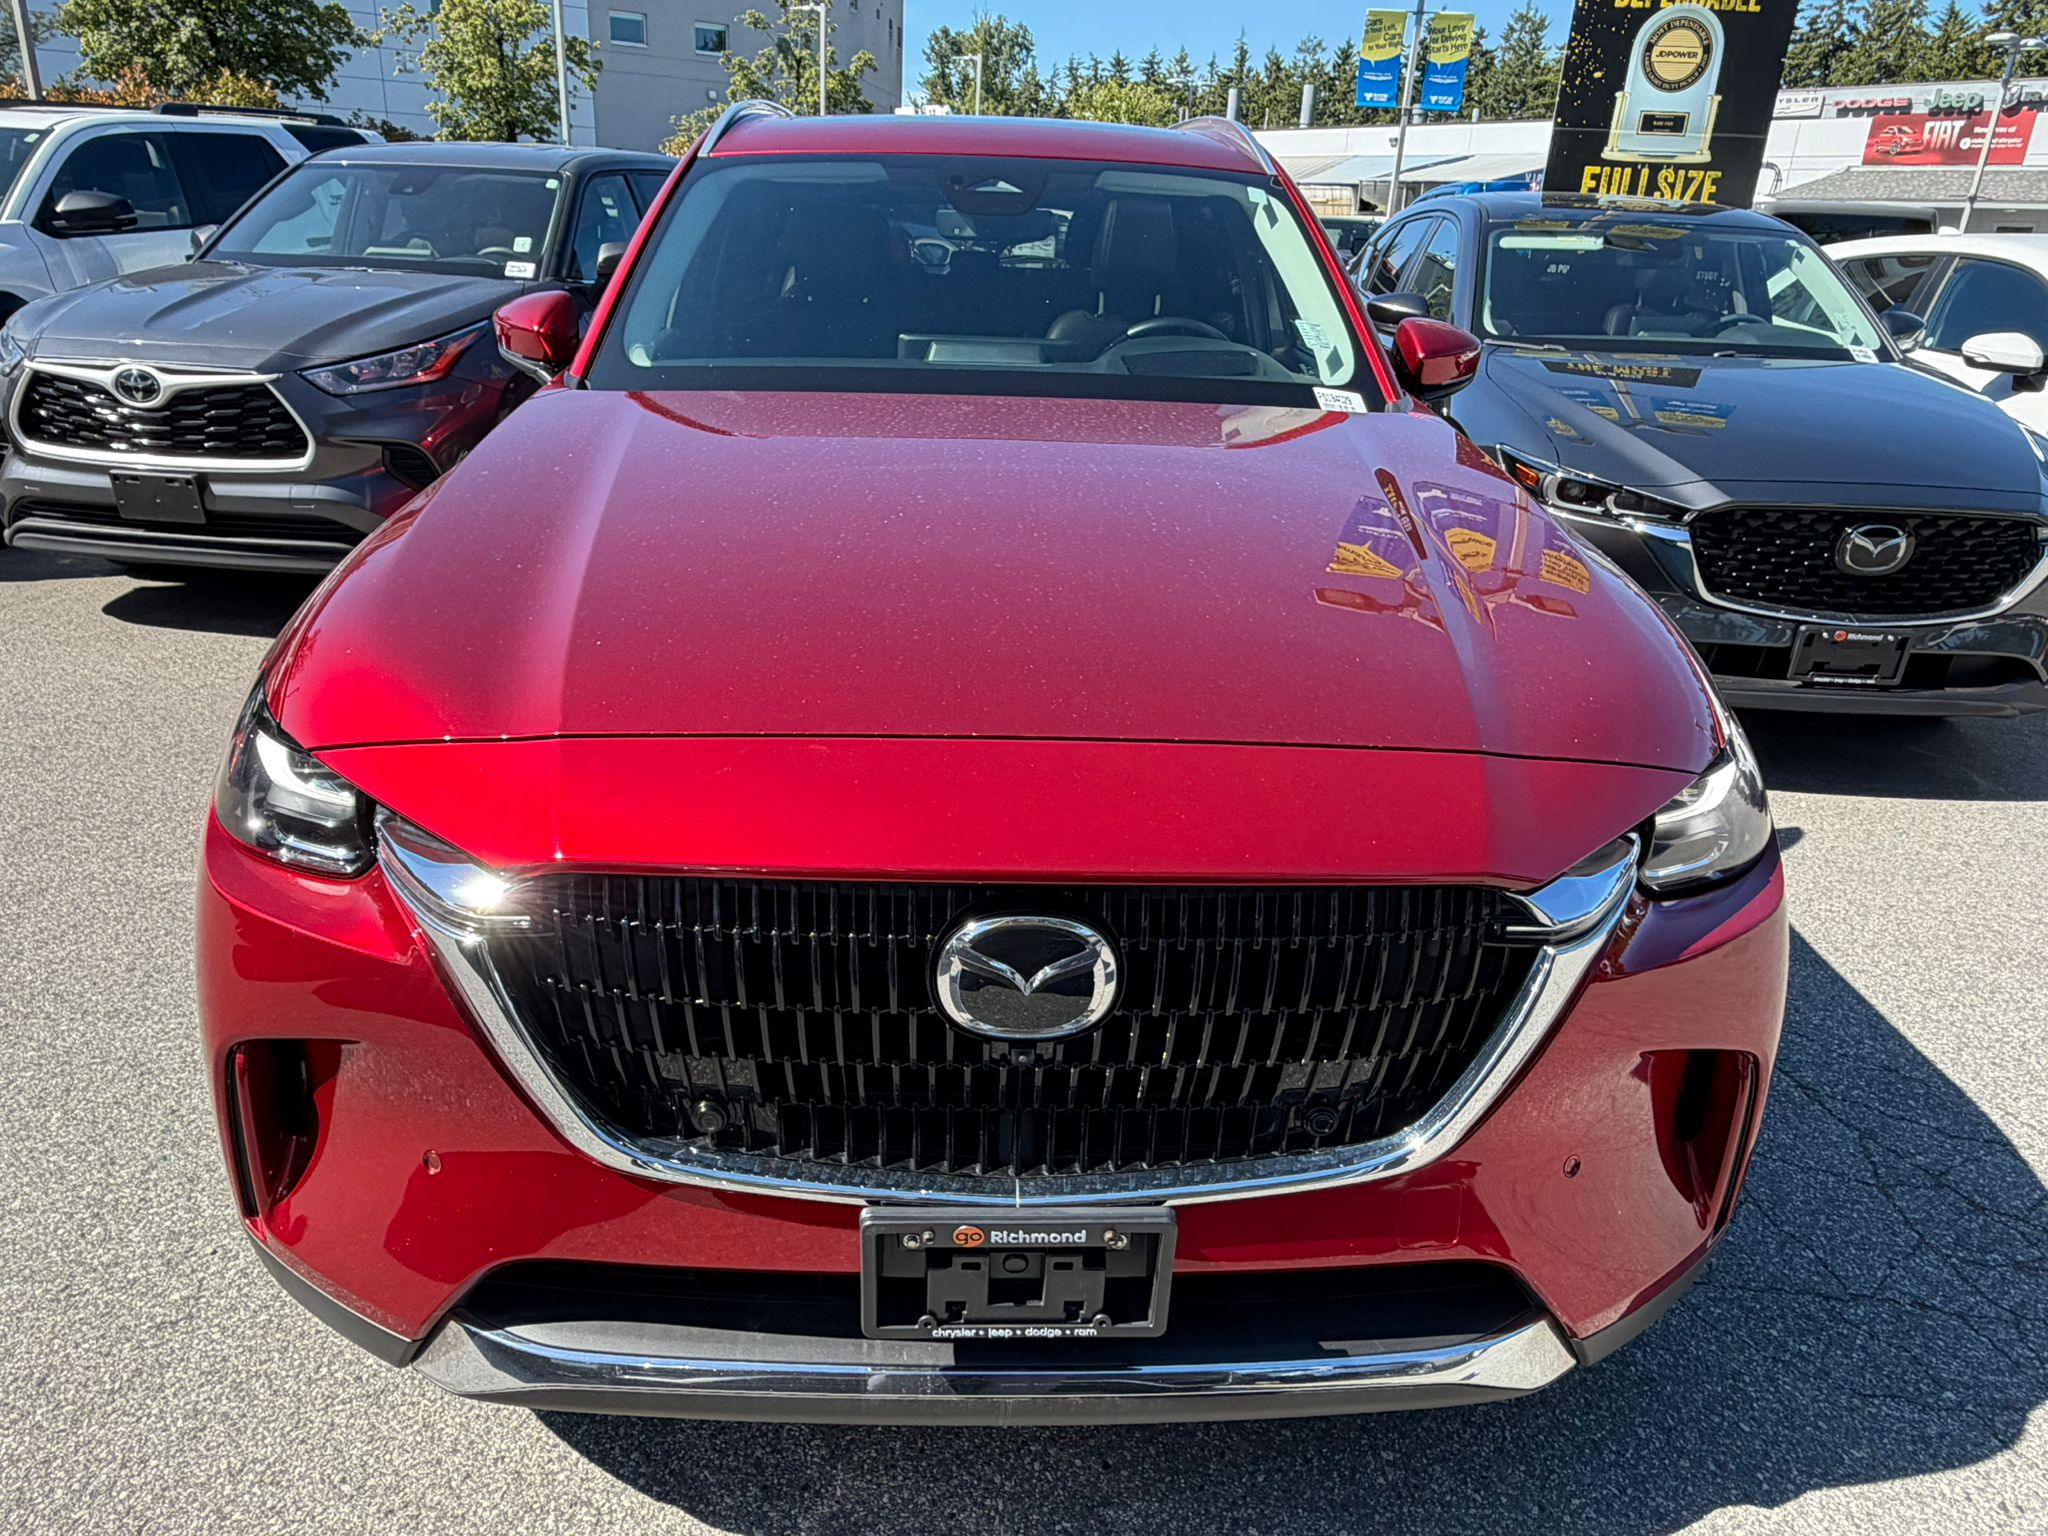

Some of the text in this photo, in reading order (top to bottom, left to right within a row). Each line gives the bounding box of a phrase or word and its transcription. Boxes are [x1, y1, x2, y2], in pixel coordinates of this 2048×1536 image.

[1650, 20, 1710, 46] MOST DEPENDABLE
[1832, 97, 1912, 109] DODGE
[1924, 88, 1980, 111] Jeep
[1923, 120, 1967, 150] FIAT
[955, 1229, 1087, 1247] go Richmond
[932, 1327, 1097, 1339] chrysler jeep dodge ram
